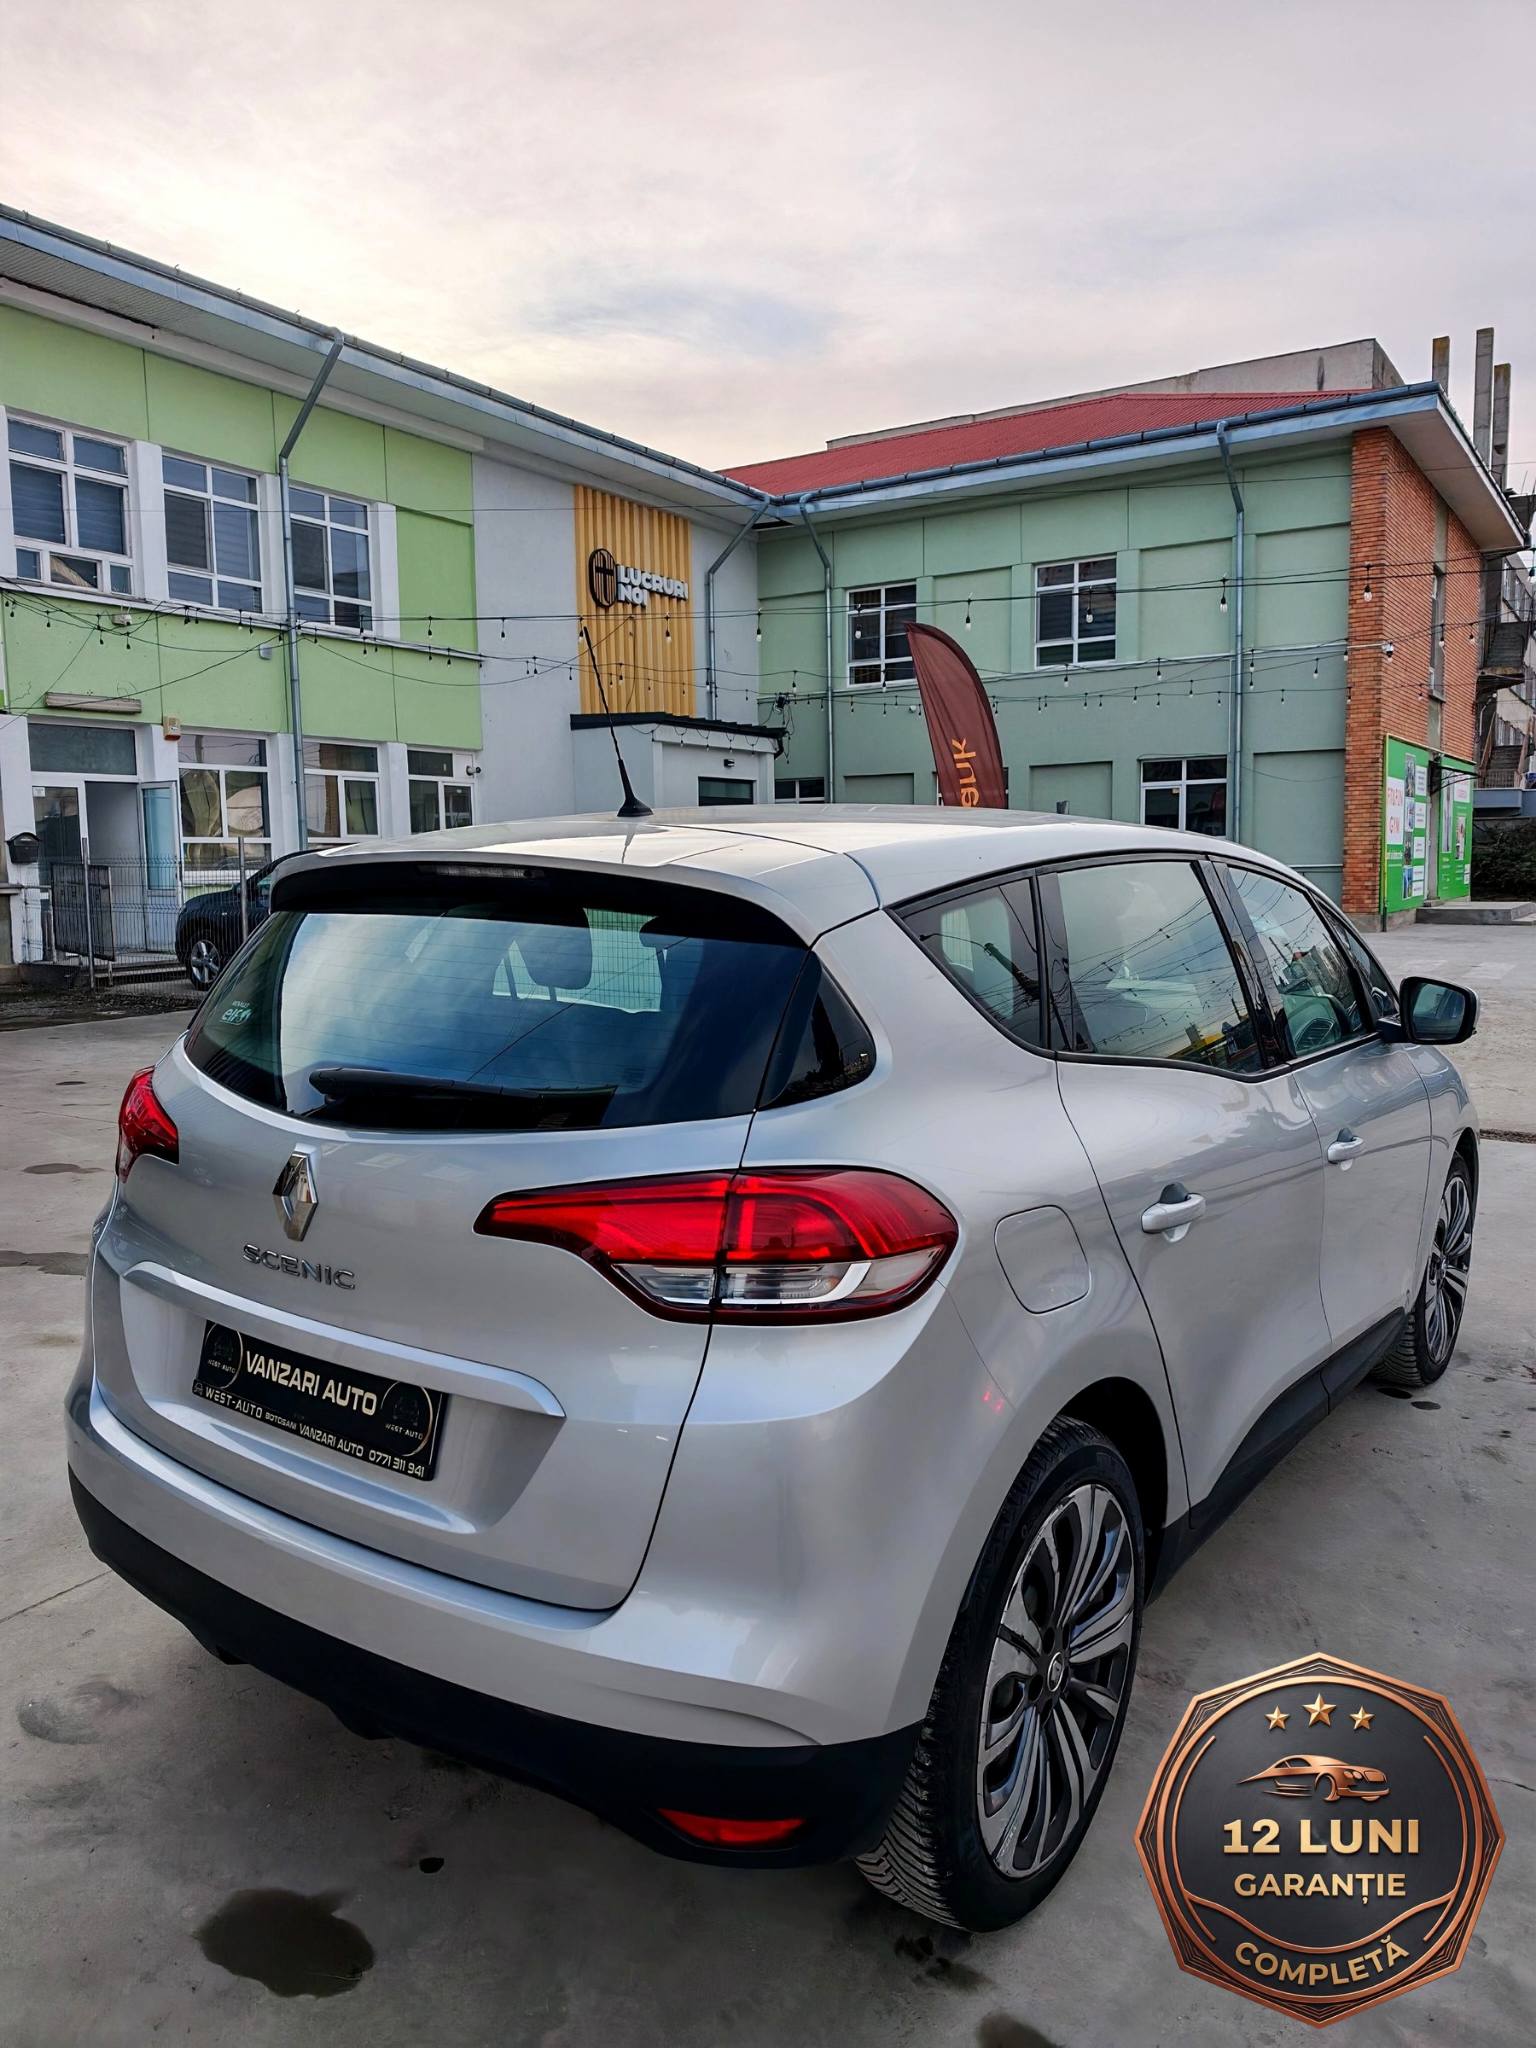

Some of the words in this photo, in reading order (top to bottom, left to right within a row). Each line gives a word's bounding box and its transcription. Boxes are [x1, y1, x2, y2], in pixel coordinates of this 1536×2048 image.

[616, 565, 688, 600] LUCRURI
[616, 583, 648, 606] NOI
[242, 1243, 356, 1290] SCENIC
[246, 1350, 320, 1397] VANZARI
[322, 1379, 378, 1417] AUTO
[205, 1386, 263, 1418] WEST-AUTO
[300, 1423, 336, 1448] VANZARI
[337, 1438, 364, 1457] AUTO
[368, 1449, 391, 1467] 0771
[393, 1456, 406, 1471] 311
[408, 1462, 425, 1478] 941
